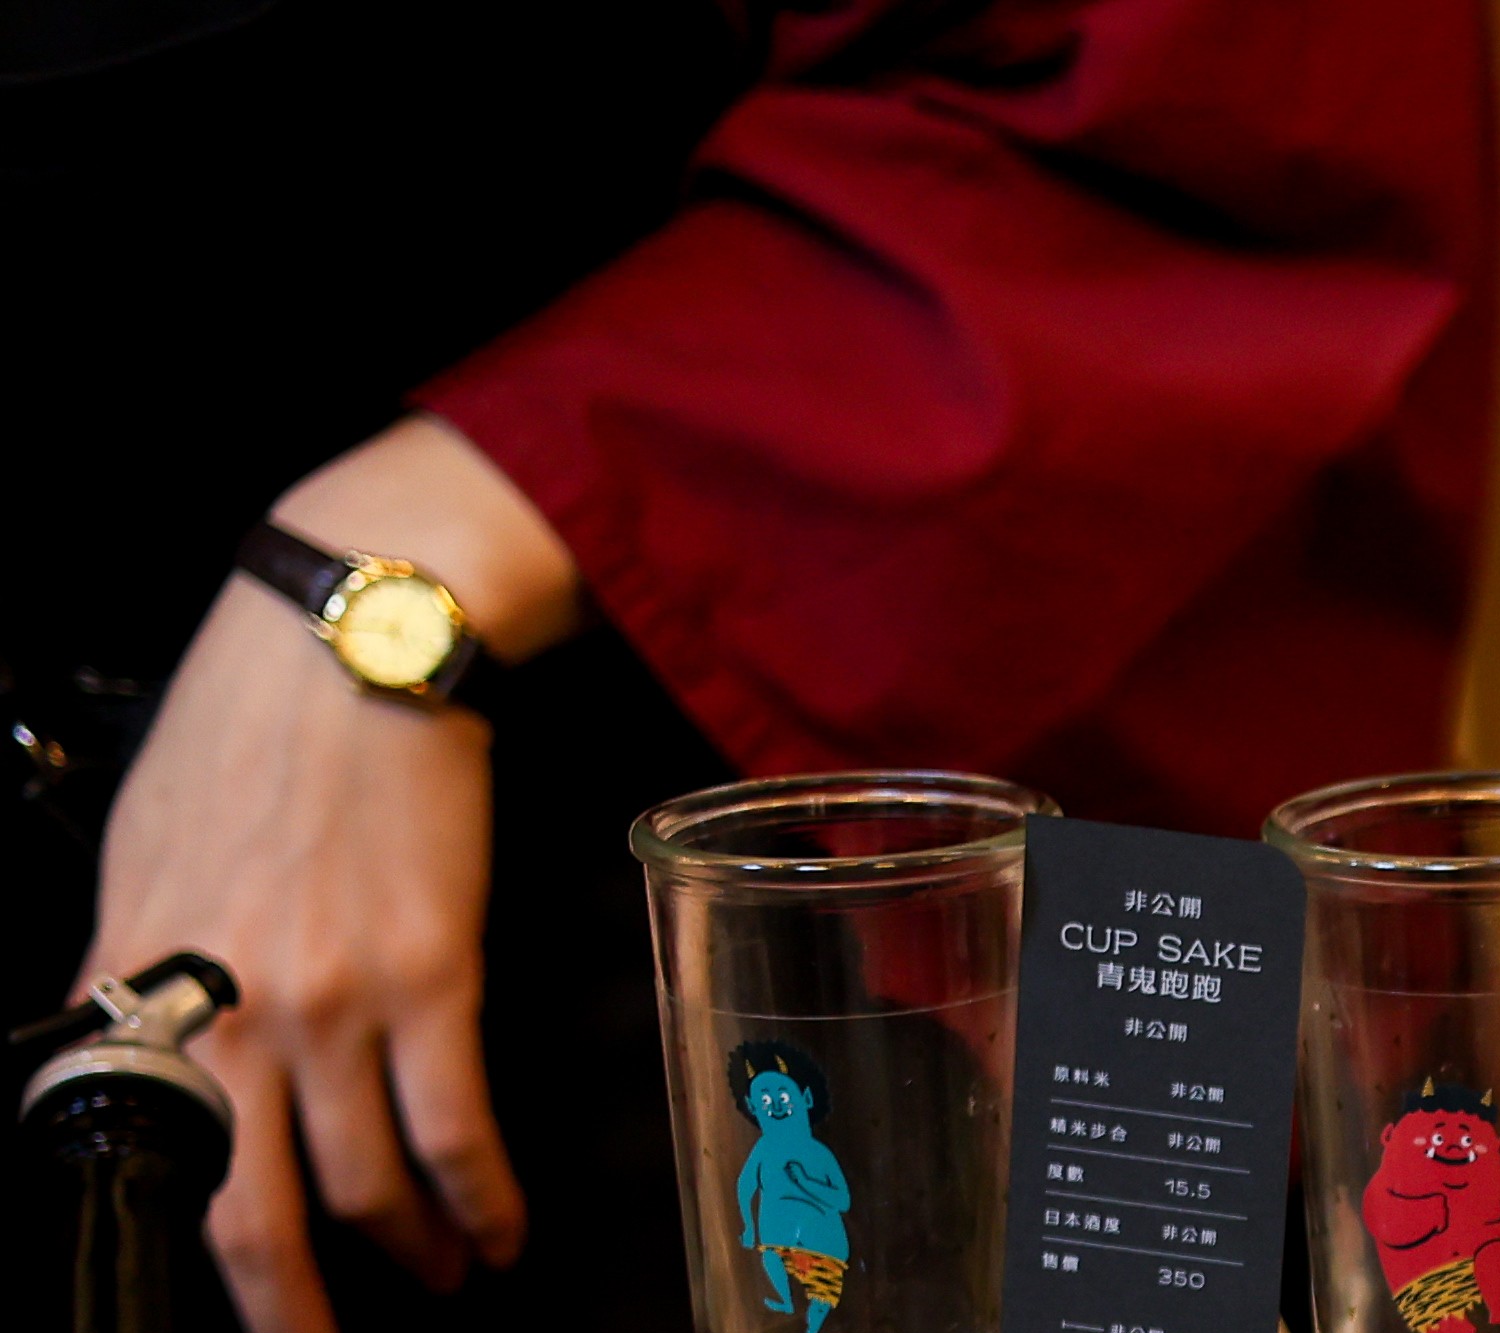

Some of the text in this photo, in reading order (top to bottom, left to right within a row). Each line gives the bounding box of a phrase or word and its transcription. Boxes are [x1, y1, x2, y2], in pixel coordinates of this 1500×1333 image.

[1125, 890, 1201, 919] 非公開
[1061, 923, 1263, 973] CUP SAKE
[1096, 962, 1223, 1002] 青鬼跑跑
[1125, 1018, 1187, 1042] 非公開
[1165, 1180, 1210, 1199] 15.5
[1159, 1269, 1204, 1288] 350
